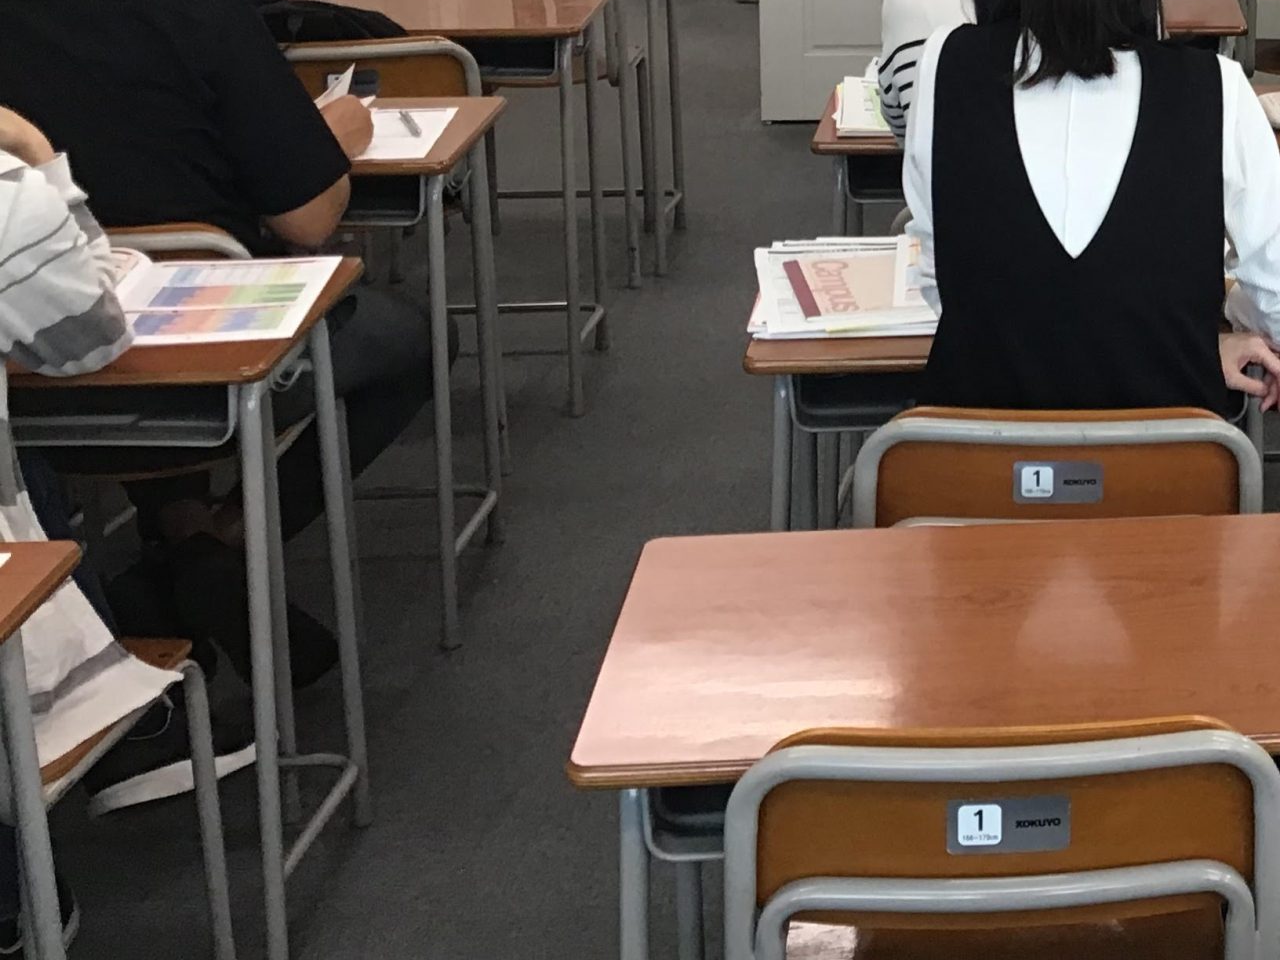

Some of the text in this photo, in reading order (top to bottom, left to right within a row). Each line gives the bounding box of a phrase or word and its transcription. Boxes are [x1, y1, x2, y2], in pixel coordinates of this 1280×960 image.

[812, 260, 860, 313] Campus
[1033, 470, 1040, 487] 1
[974, 809, 984, 831] 1
[1015, 817, 1061, 829] KOKUYO
